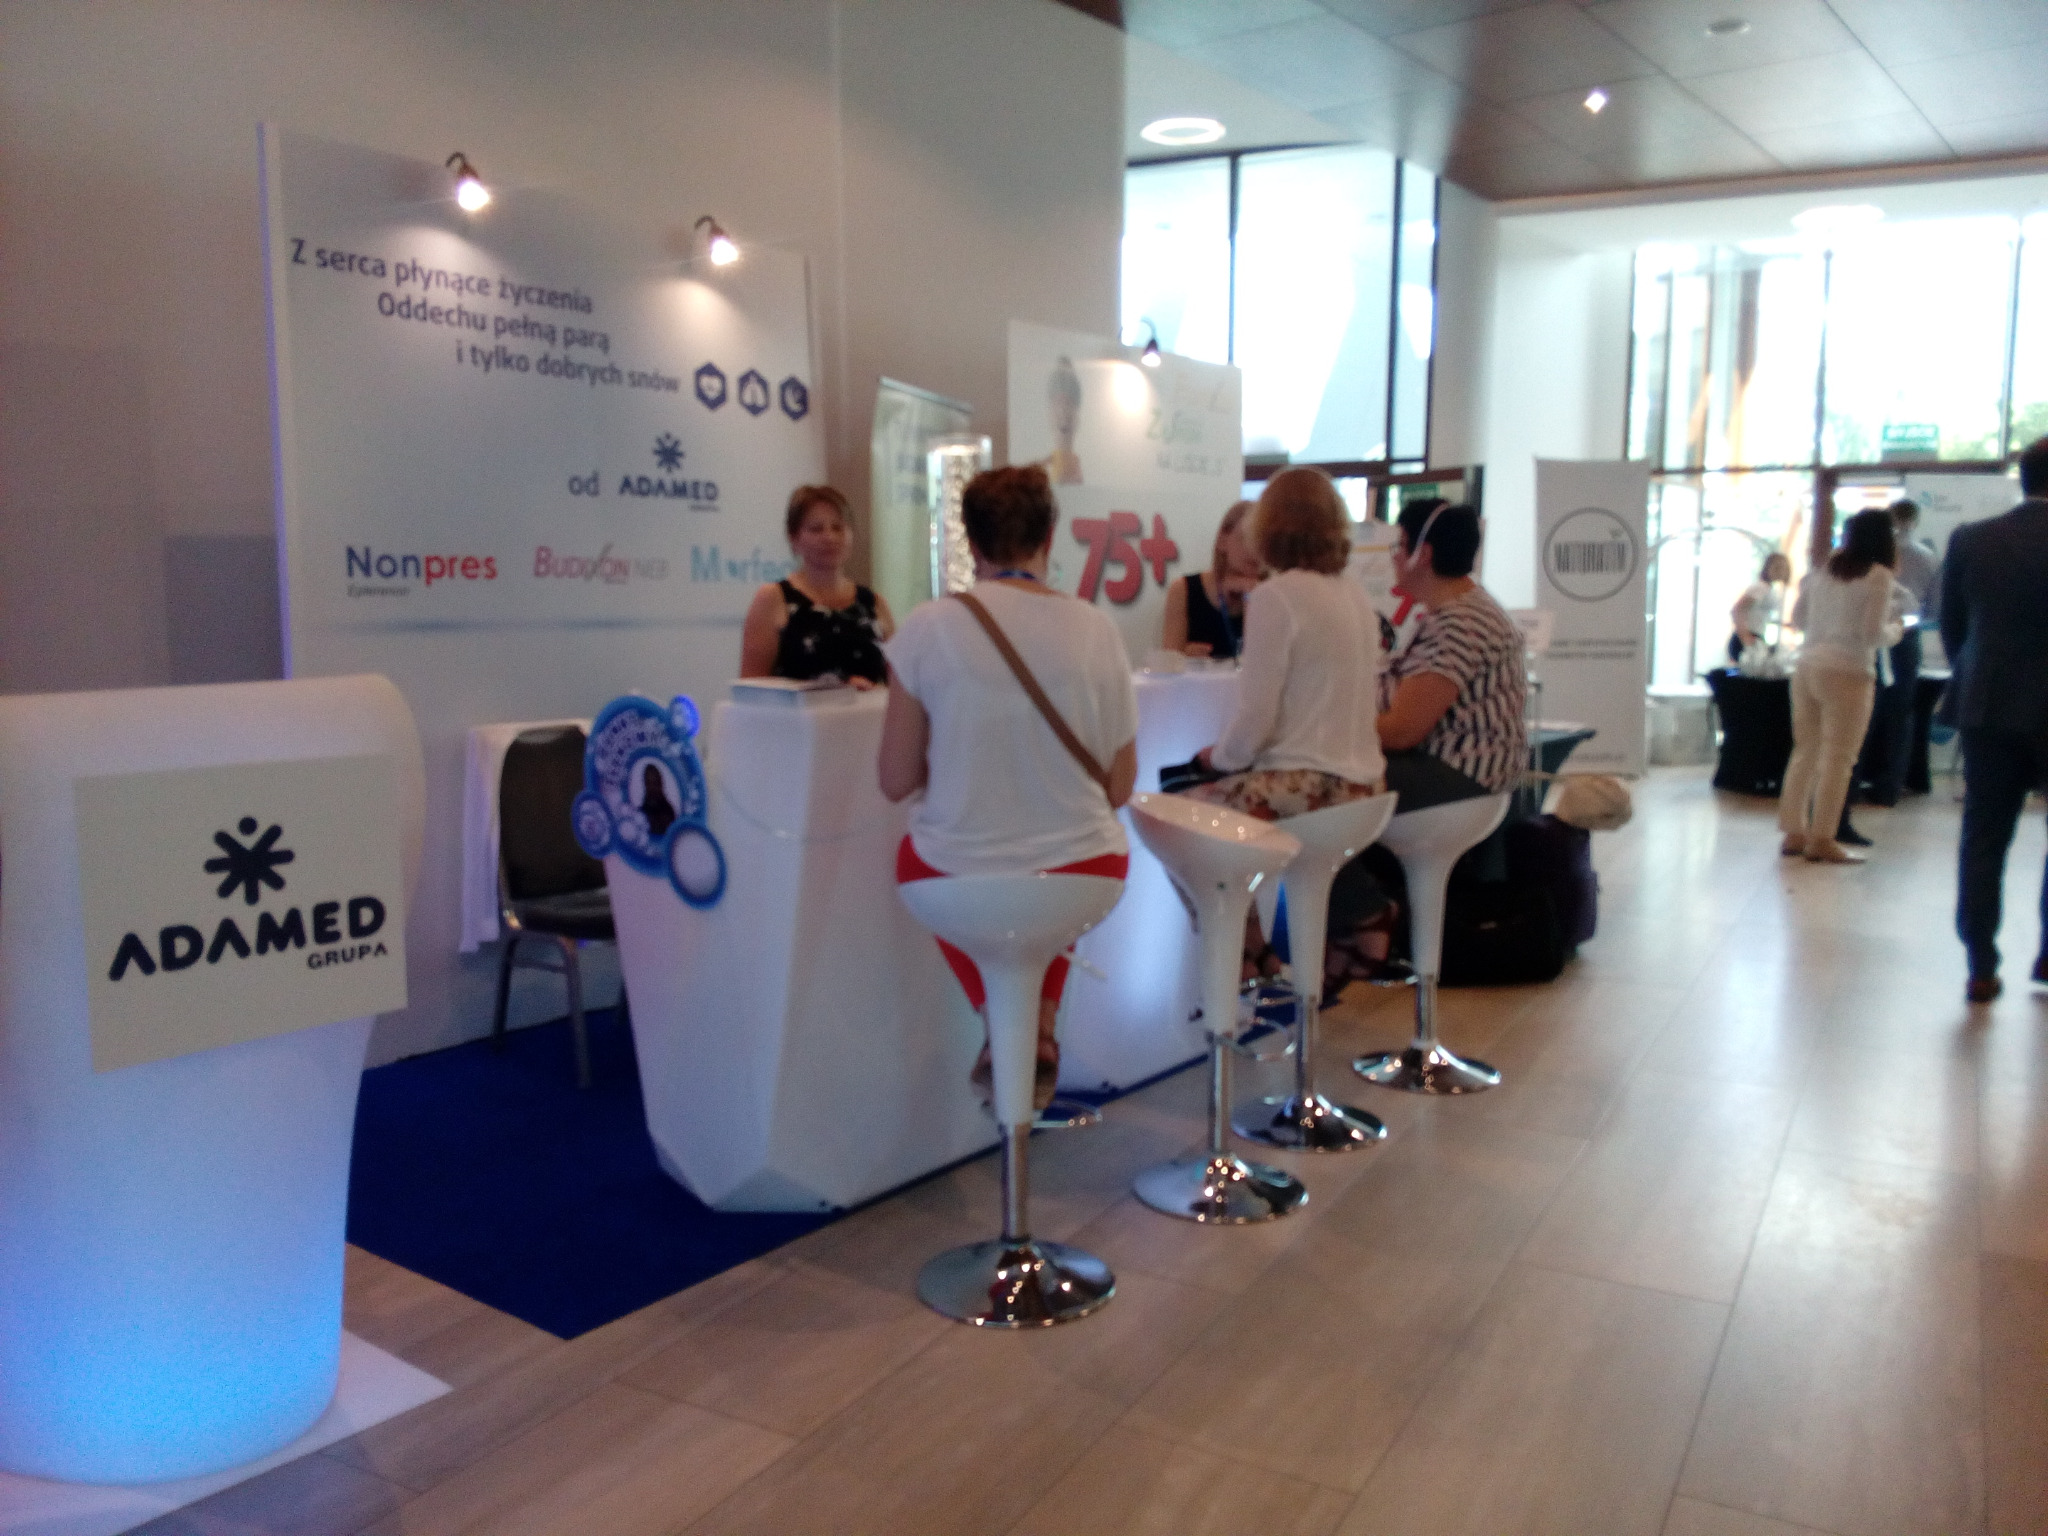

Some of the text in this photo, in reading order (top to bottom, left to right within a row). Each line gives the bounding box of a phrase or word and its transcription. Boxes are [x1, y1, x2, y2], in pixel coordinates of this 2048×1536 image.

[290, 237, 306, 265] Z
[315, 248, 386, 278] serca
[378, 291, 487, 332] Oddechu
[456, 339, 463, 364] i
[470, 344, 530, 373] tylko
[536, 354, 623, 386] dobrych
[568, 471, 719, 501] od ADAMED
[346, 546, 498, 587] Nonpres
[1071, 511, 1178, 604] 75+
[108, 896, 386, 981] ADAMED
[307, 942, 388, 969] GRUPA
